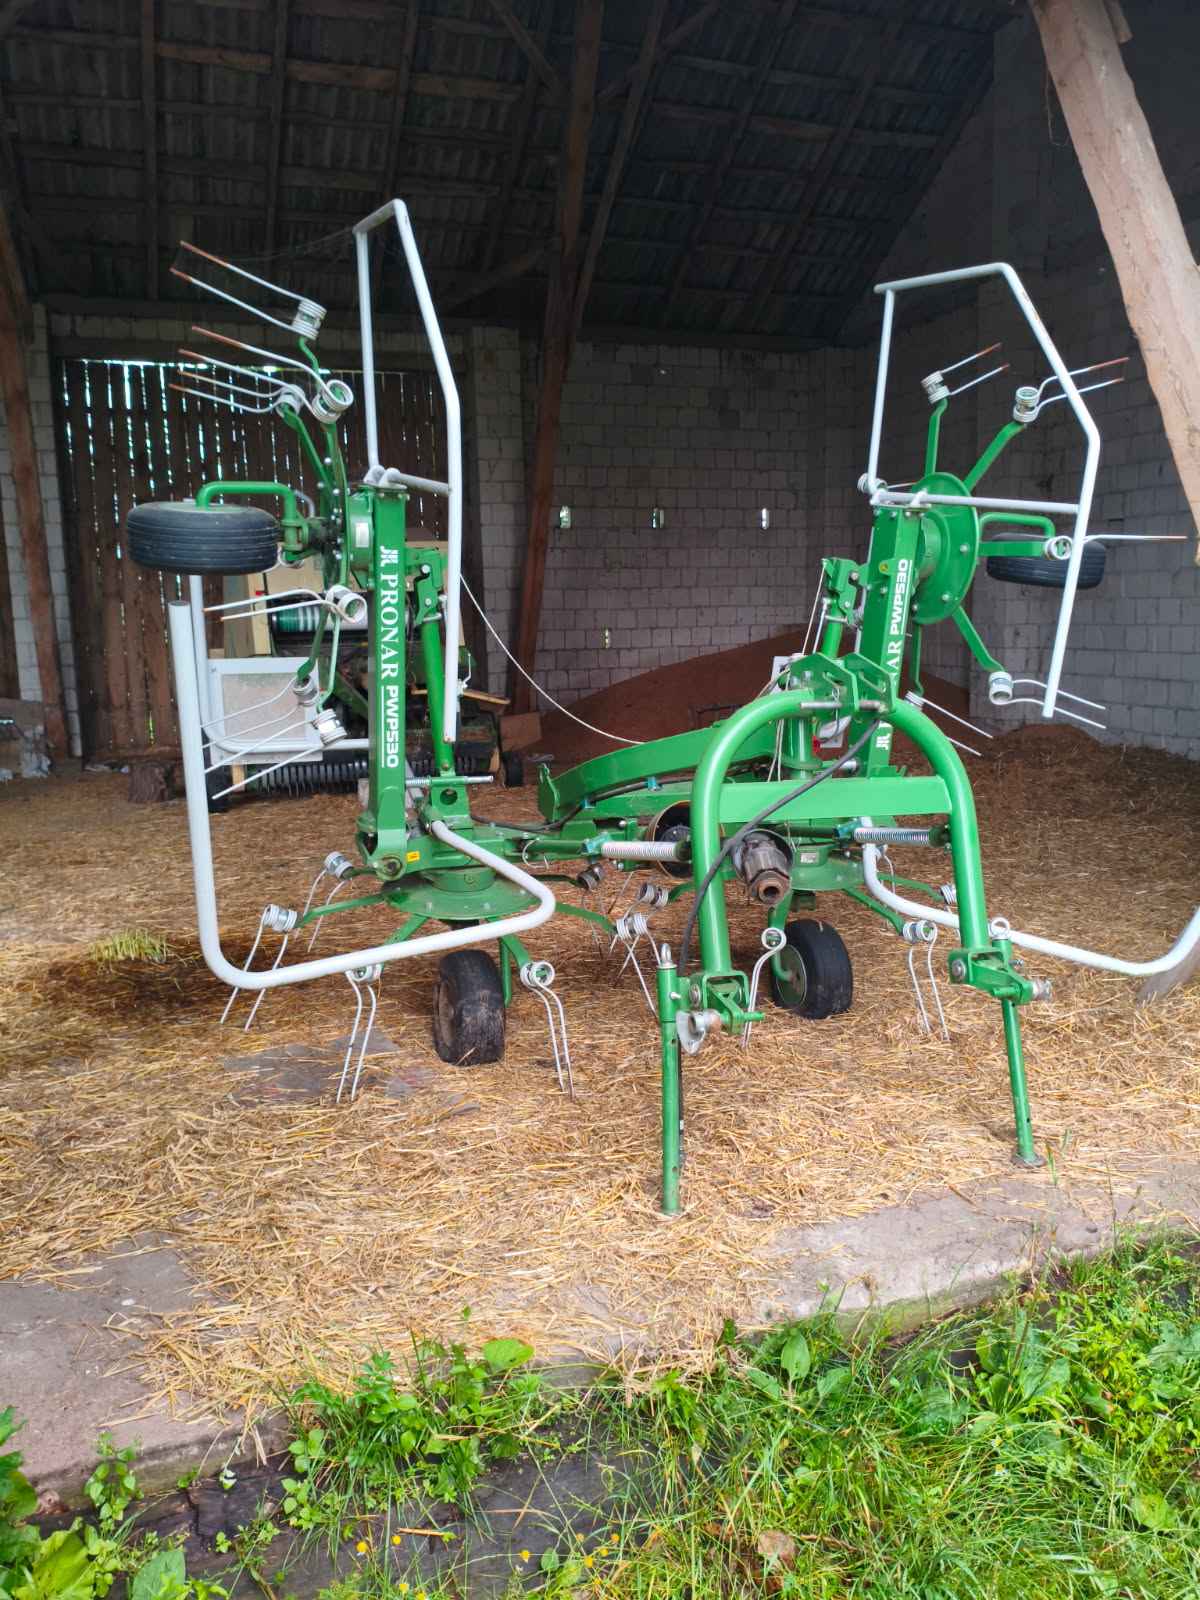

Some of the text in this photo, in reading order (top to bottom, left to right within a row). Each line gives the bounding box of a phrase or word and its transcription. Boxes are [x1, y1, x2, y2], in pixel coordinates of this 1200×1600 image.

[889, 559, 909, 636] PWP530
[380, 574, 400, 768] PRONAR PWP530
